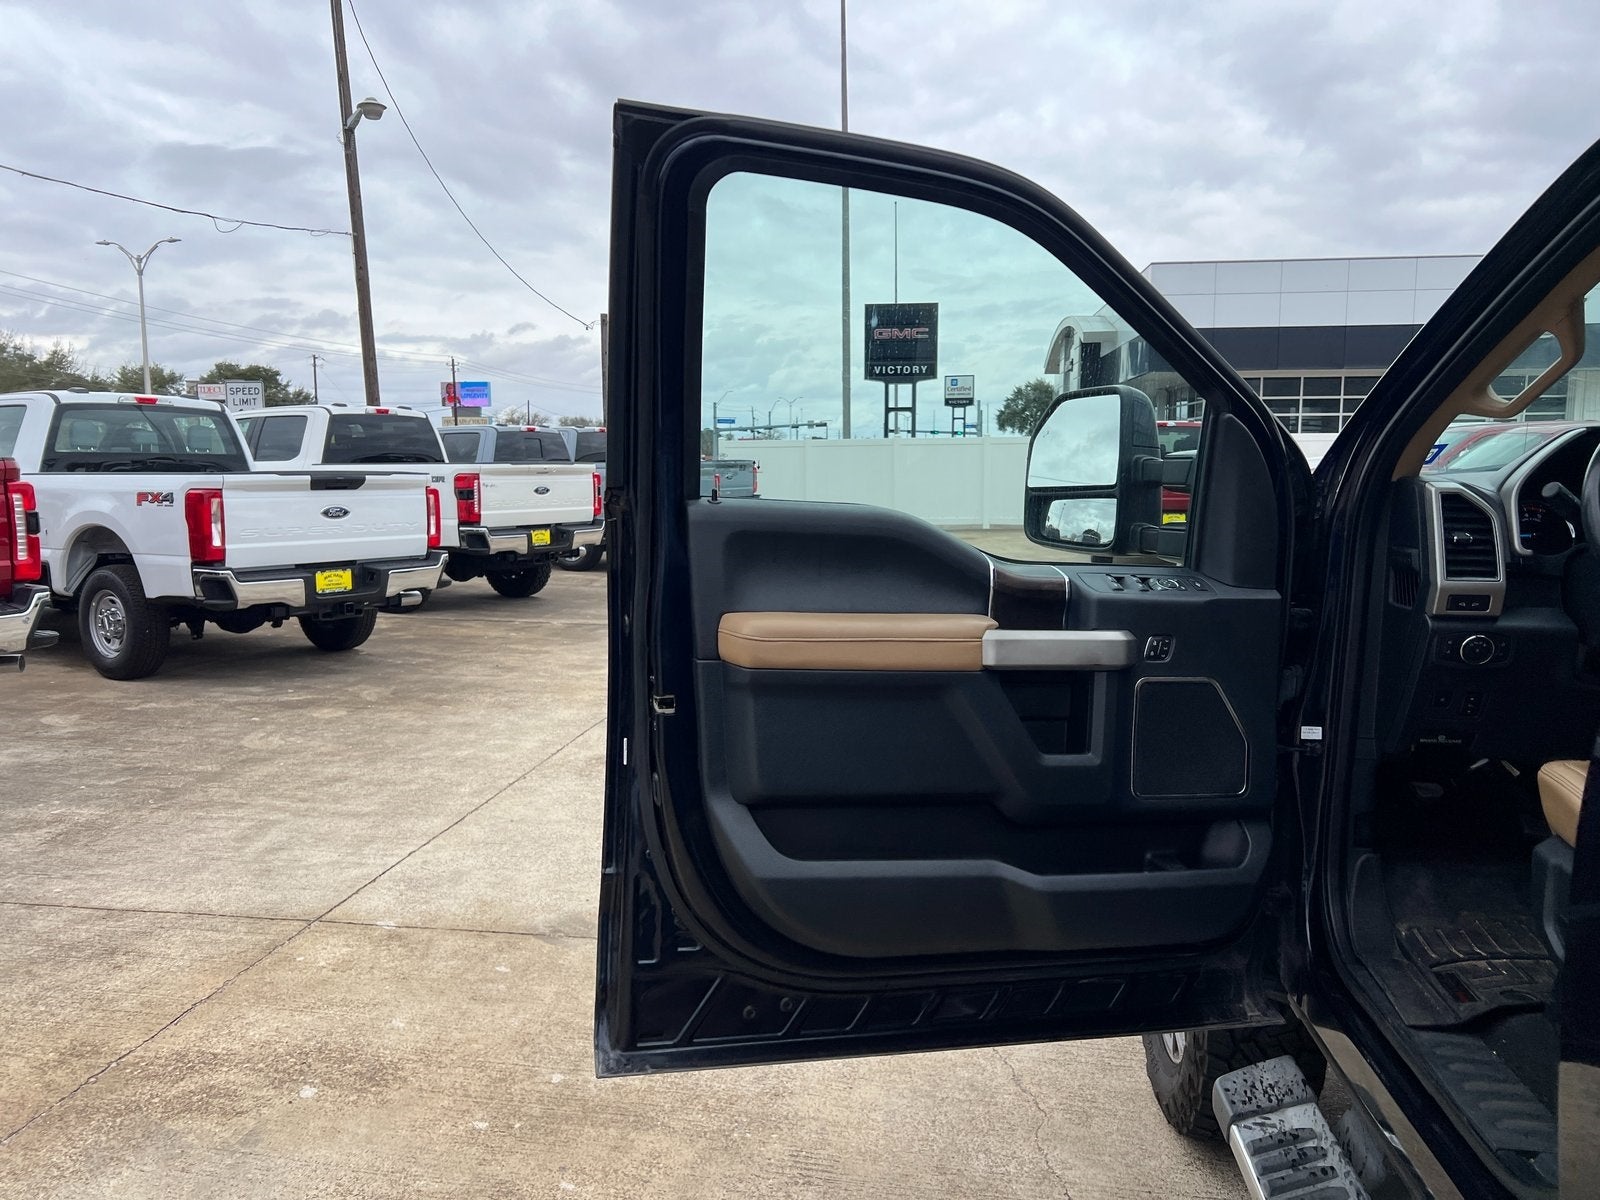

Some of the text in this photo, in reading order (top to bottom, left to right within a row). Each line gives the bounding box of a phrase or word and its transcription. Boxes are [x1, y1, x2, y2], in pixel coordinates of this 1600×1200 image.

[874, 328, 929, 339] GMC
[874, 365, 928, 374] VICTORY
[229, 387, 260, 396] SPEED
[232, 398, 257, 406] LIMIT
[136, 491, 174, 506] FX4
[239, 521, 419, 538] SUPER DUTY
